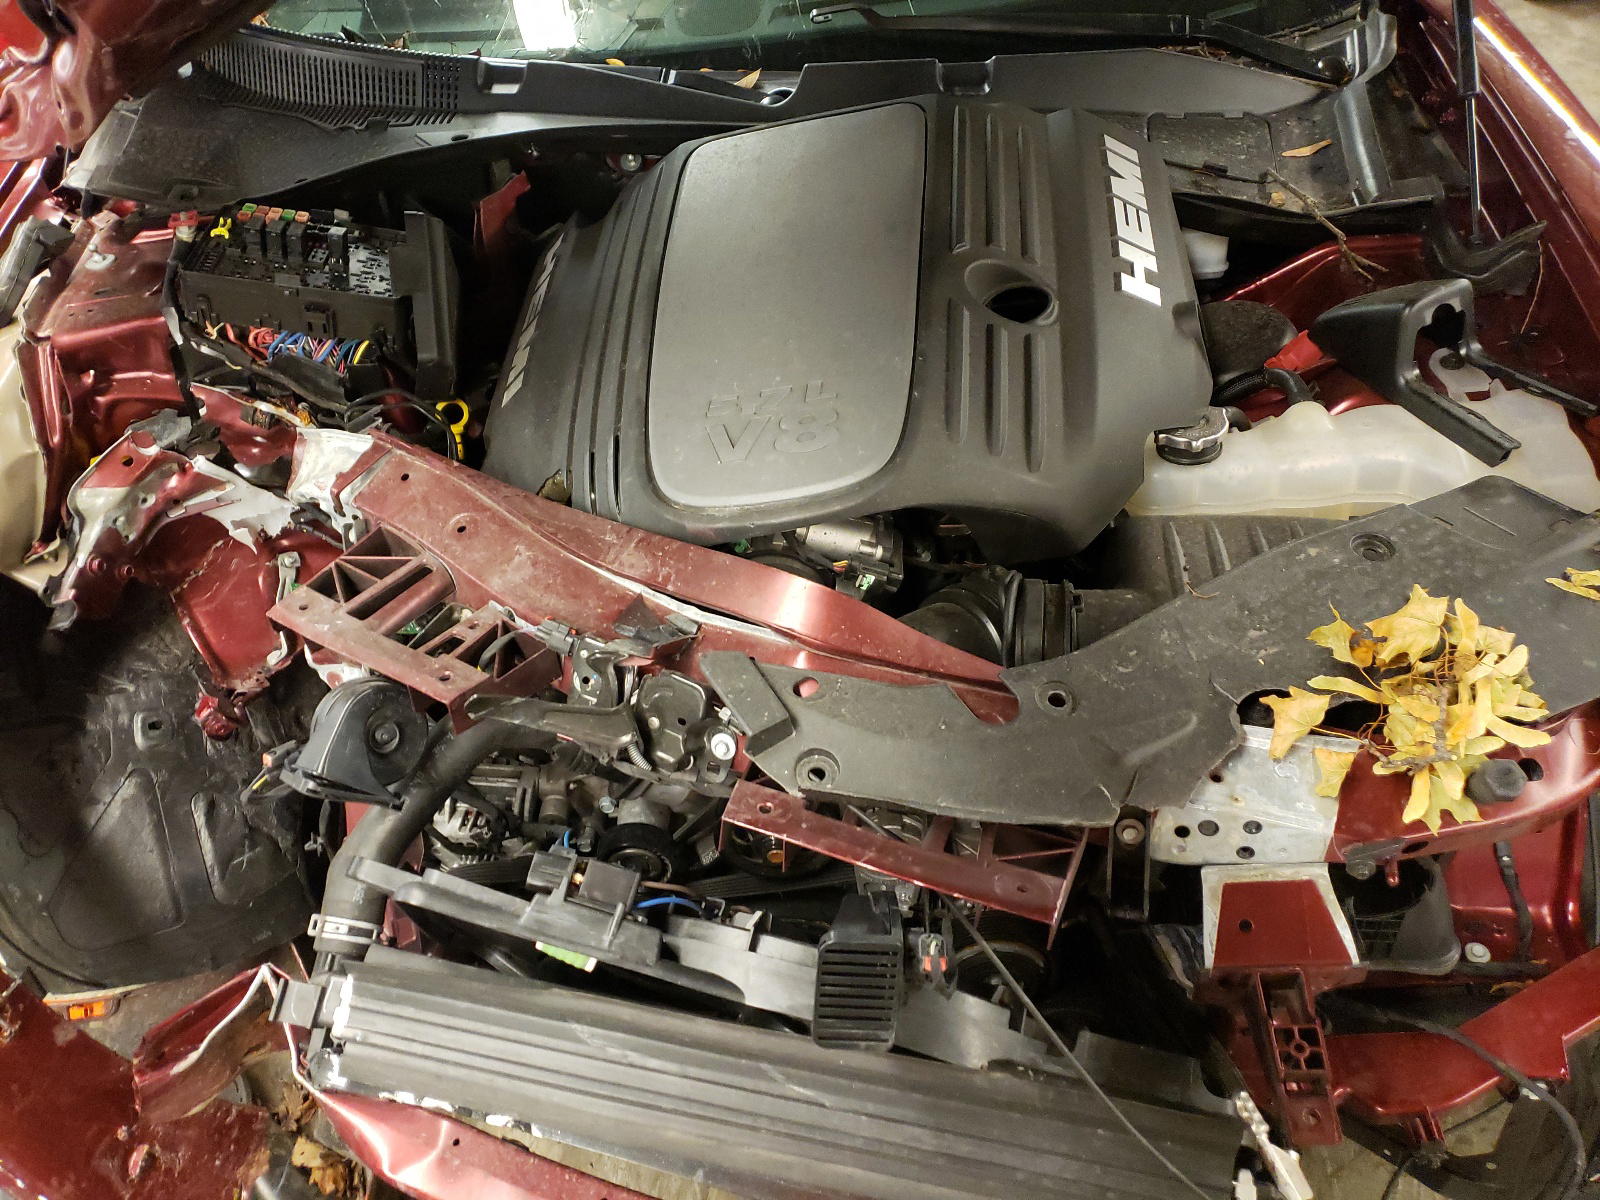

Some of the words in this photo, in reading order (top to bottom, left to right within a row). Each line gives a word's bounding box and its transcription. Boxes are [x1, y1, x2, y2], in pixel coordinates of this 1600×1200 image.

[1103, 133, 1162, 307] HEMI
[501, 232, 564, 409] HEMI
[705, 406, 840, 464] V8
